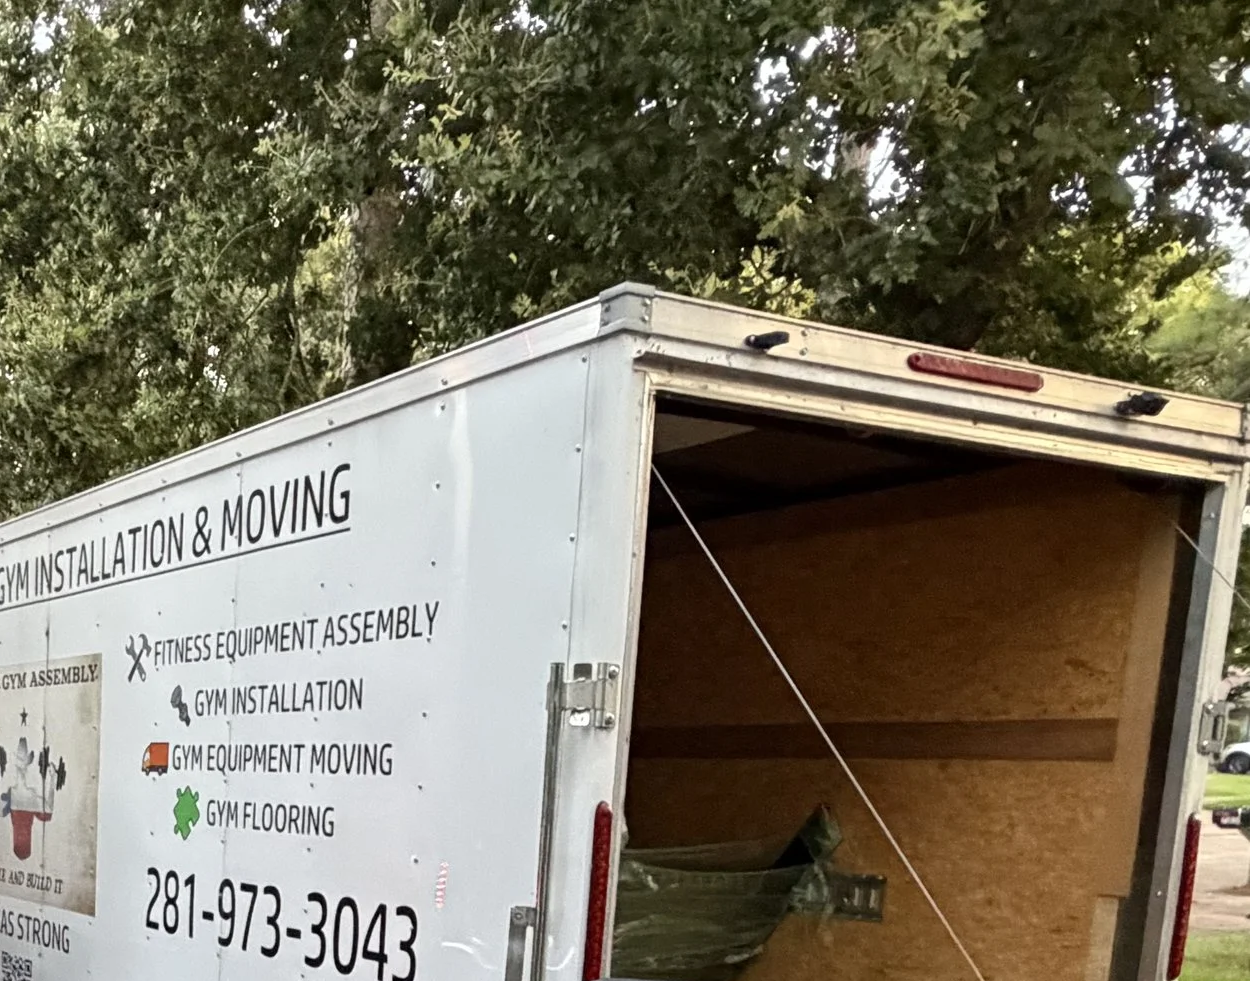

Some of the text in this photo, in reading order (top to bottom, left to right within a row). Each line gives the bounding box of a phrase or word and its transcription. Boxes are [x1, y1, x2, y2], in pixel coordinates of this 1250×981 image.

[34, 511, 185, 598] INSTALLATION
[192, 505, 212, 558] &
[220, 462, 351, 552] MOVING
[153, 600, 441, 667] FITNESS EQUIPMENT ASSEMBLY
[1, 672, 28, 691] GYM
[194, 677, 364, 717] GYM INSTALLATION
[171, 743, 393, 776] GYM EQUIPMENT MOVING
[206, 799, 336, 838] GYM FLOORING
[7, 870, 25, 886] AND
[26, 873, 53, 892] BUILD
[53, 878, 63, 895] IT
[17, 913, 70, 954] STRONG
